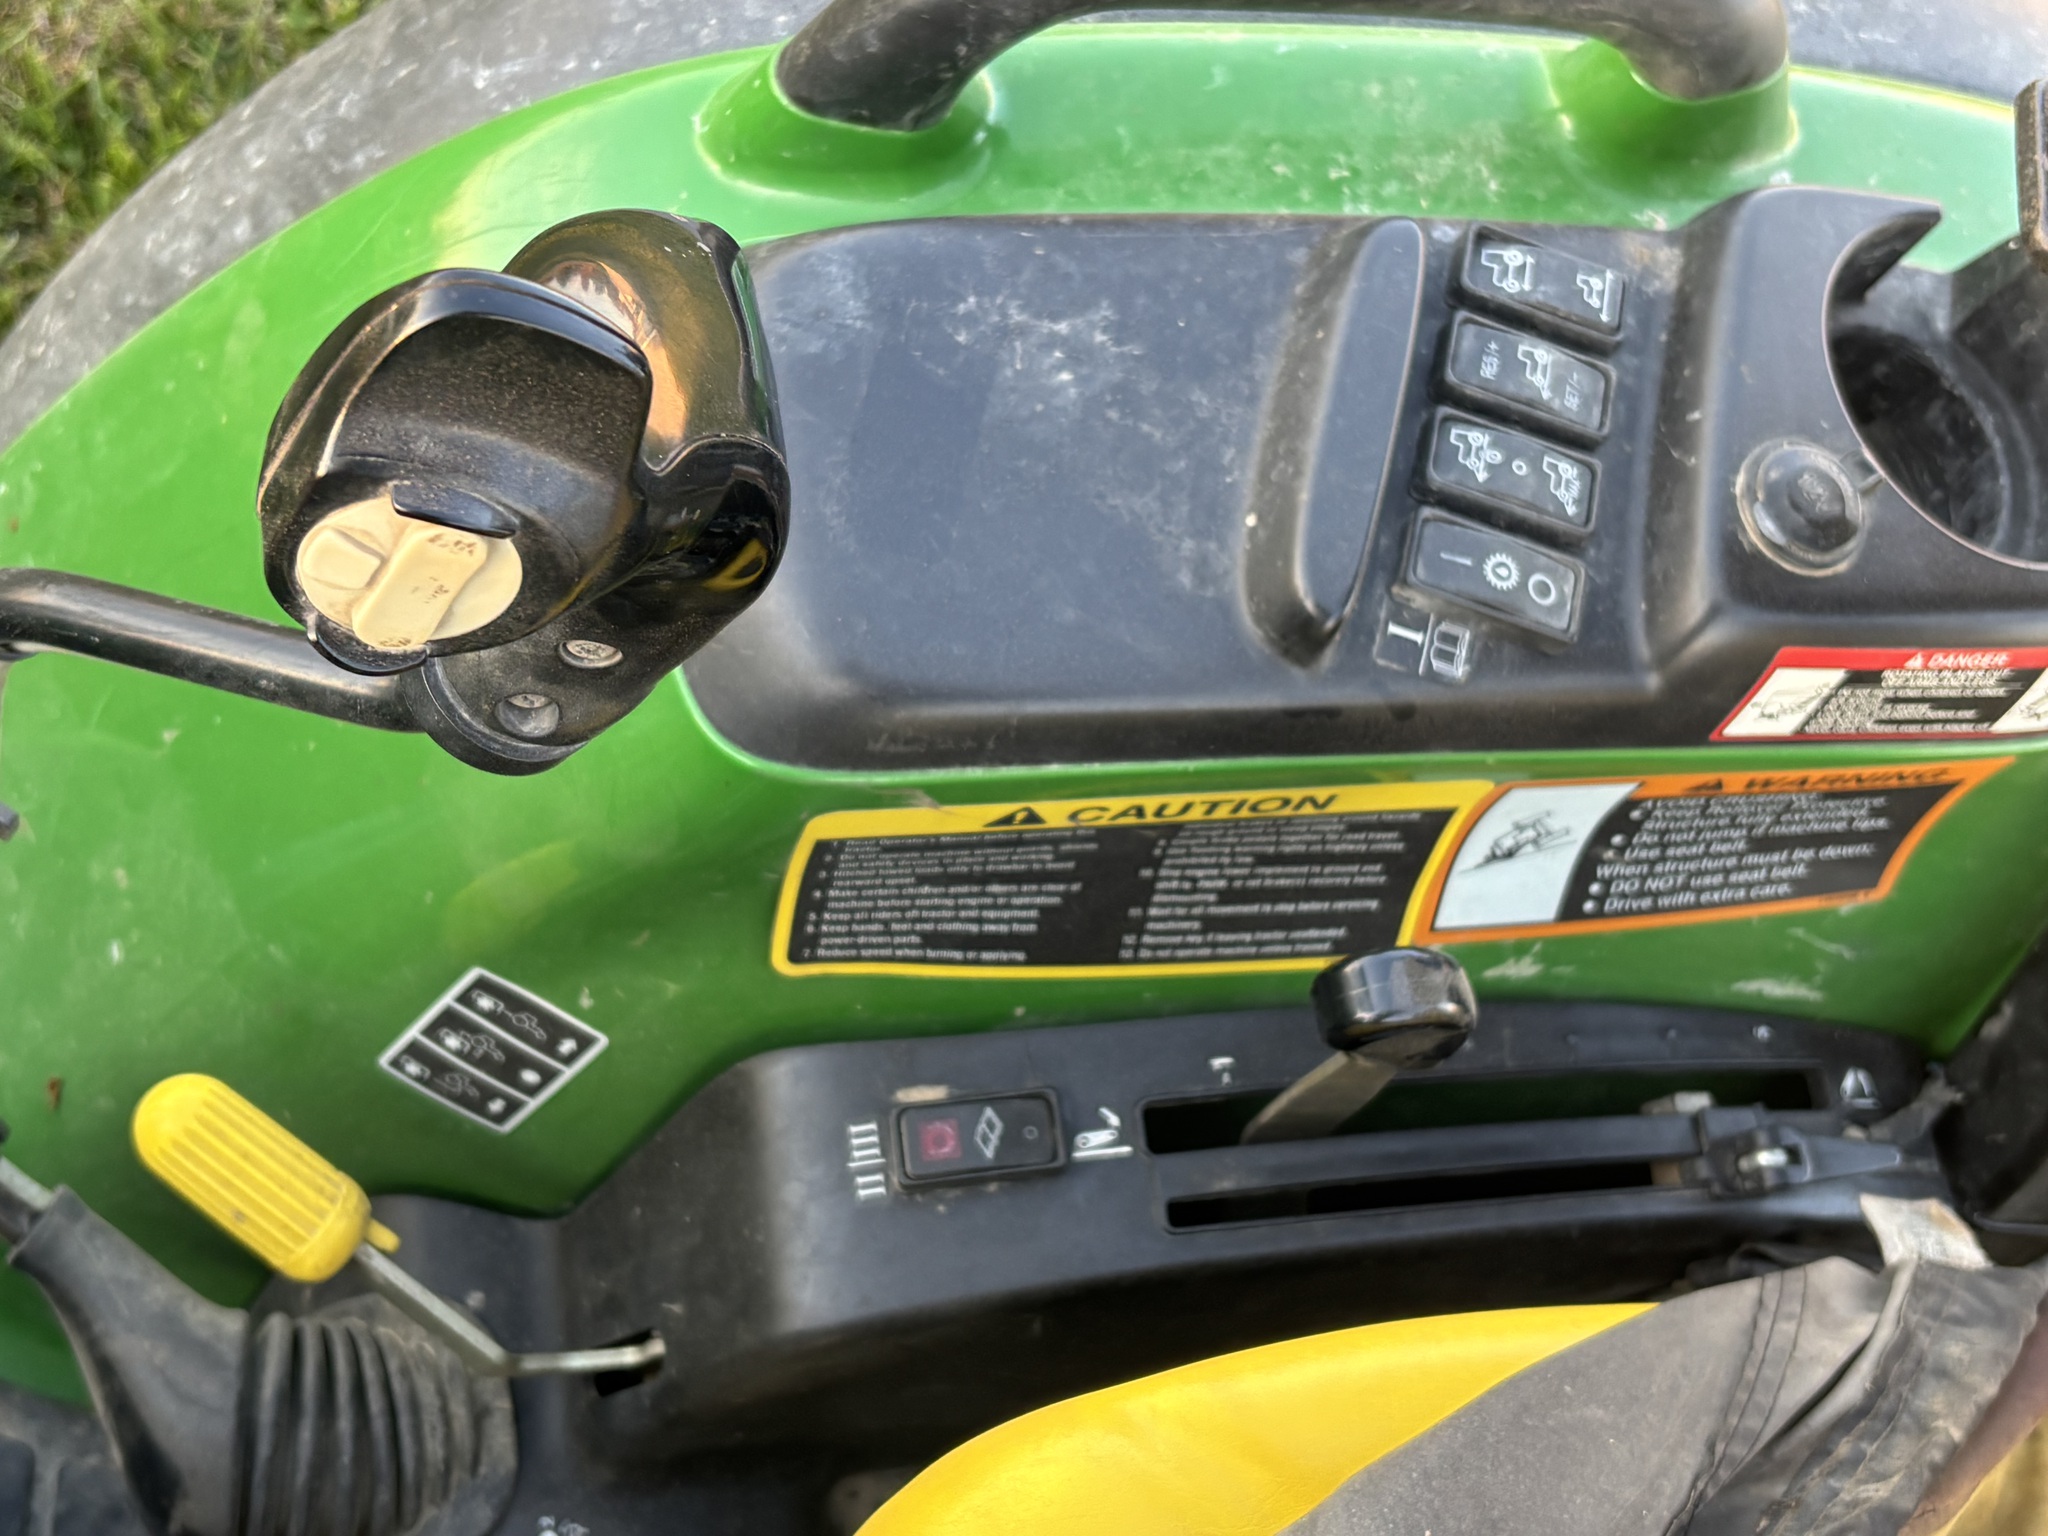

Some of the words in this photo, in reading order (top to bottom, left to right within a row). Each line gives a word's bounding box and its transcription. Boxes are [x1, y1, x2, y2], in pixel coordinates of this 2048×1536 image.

[1928, 652, 2012, 669] DANGER
[1067, 793, 1338, 827] CAUTION
[1631, 831, 1657, 845] Do
[1662, 829, 1698, 844] not
[1624, 847, 1662, 862] Use
[1665, 842, 1706, 857] seat
[1708, 837, 1751, 853] belt.
[1596, 861, 1648, 881] When
[1652, 854, 1739, 875] structure
[1741, 849, 1787, 867] must
[1786, 846, 1817, 862] be
[1609, 877, 1642, 896] DO
[1643, 873, 1690, 893] NOT
[1690, 872, 1726, 888] use
[1728, 867, 1770, 884] seat
[1770, 862, 1811, 879] belt.
[901, 885, 946, 895] children
[1603, 895, 1654, 915] Drive
[1657, 890, 1700, 909] with
[1699, 886, 1748, 903] extra
[1748, 881, 1795, 897] care.
[827, 900, 875, 909] machine
[876, 898, 912, 908] before
[914, 897, 956, 908] starting
[957, 896, 994, 907] engine
[823, 912, 852, 923] Keep
[870, 911, 903, 921] riders
[921, 910, 957, 920] tractor
[958, 909, 979, 919] and
[821, 923, 849, 934] Keep
[913, 923, 936, 932] and
[936, 922, 980, 934] clothing
[981, 923, 1010, 935] away
[816, 948, 858, 959] Reduce
